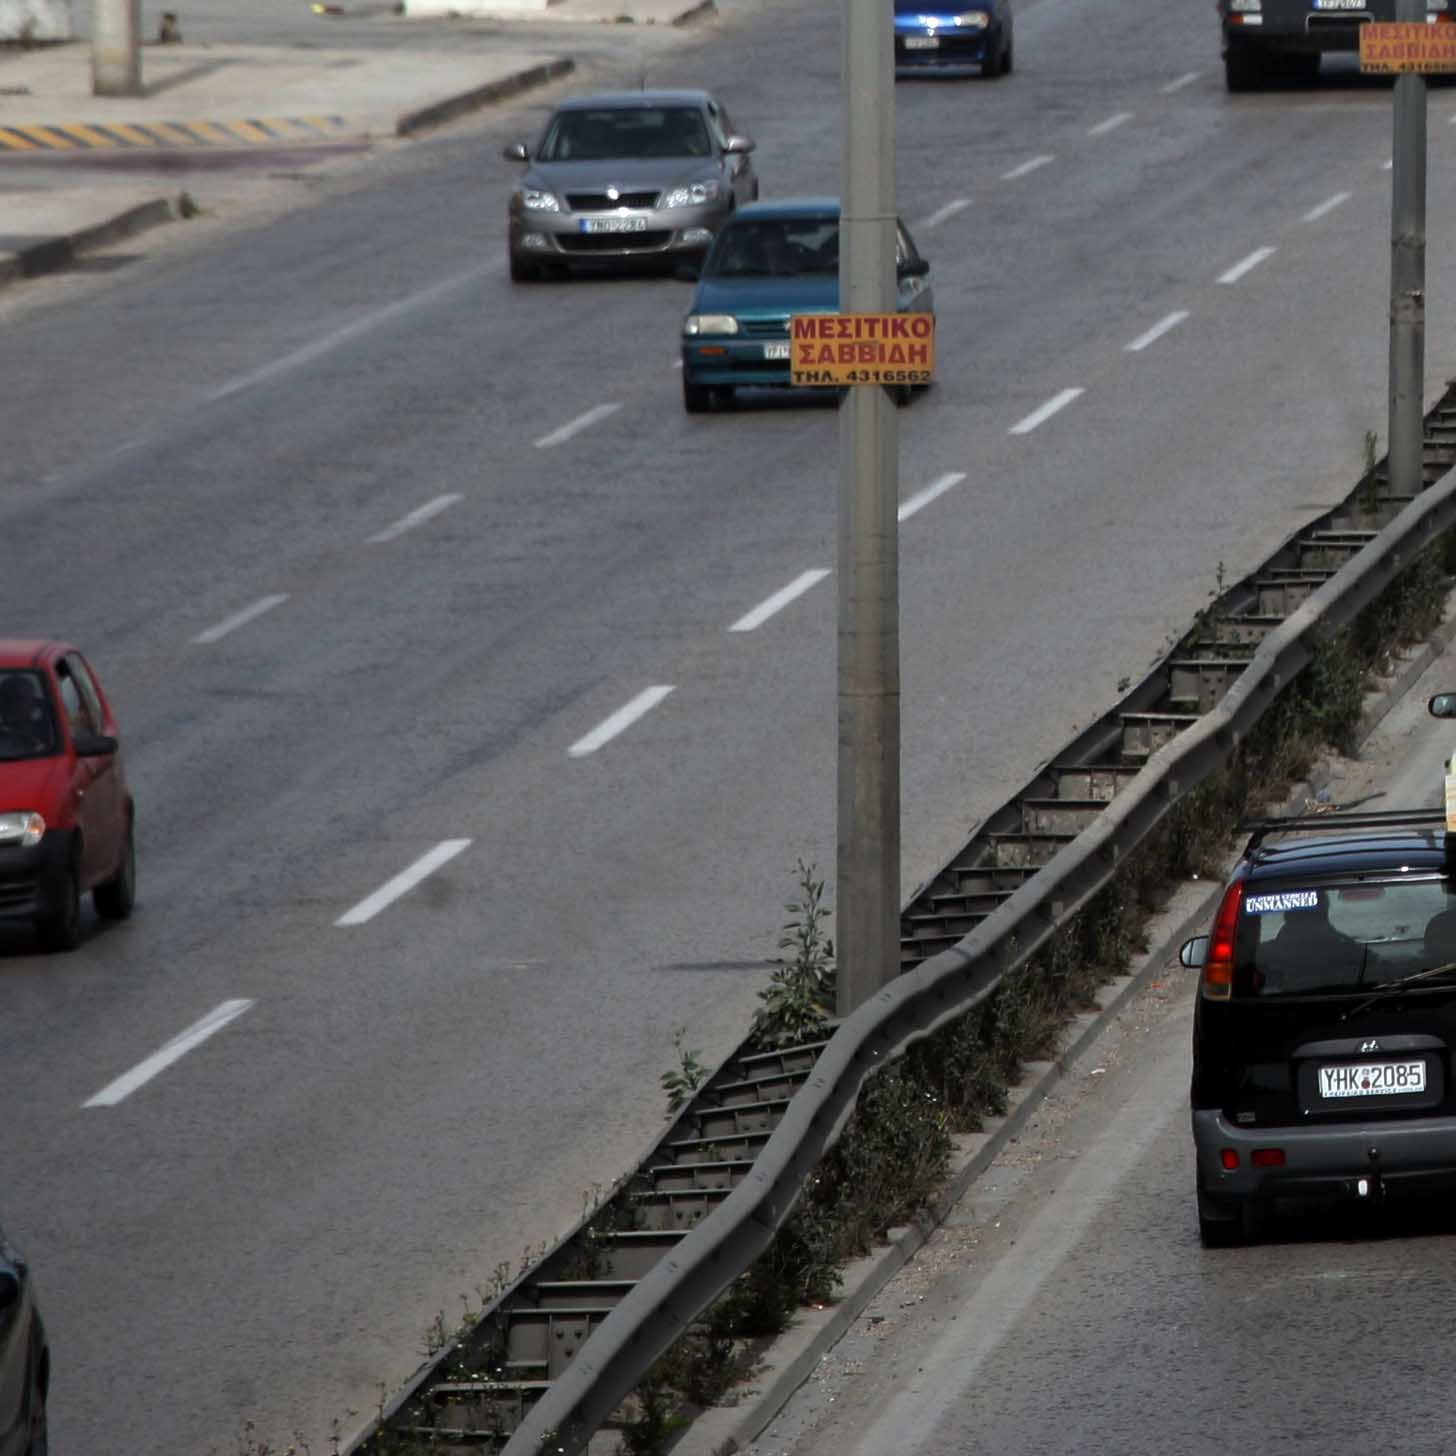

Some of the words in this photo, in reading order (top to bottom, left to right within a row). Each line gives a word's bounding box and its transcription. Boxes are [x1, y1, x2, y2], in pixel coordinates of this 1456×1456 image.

[1365, 43, 1456, 61] ΣΑΒΒΙΔΗ
[794, 317, 931, 340] ΜΕΣΙΤΙΚΟ
[799, 343, 929, 365] ΣΑΒΒΙΔΗ
[794, 370, 840, 383] ΤΗΛ.
[846, 369, 931, 383] 4316562
[1246, 896, 1319, 913] UNMANNED
[1323, 1067, 1360, 1092] YHK
[1372, 1064, 1421, 1089] 2085
